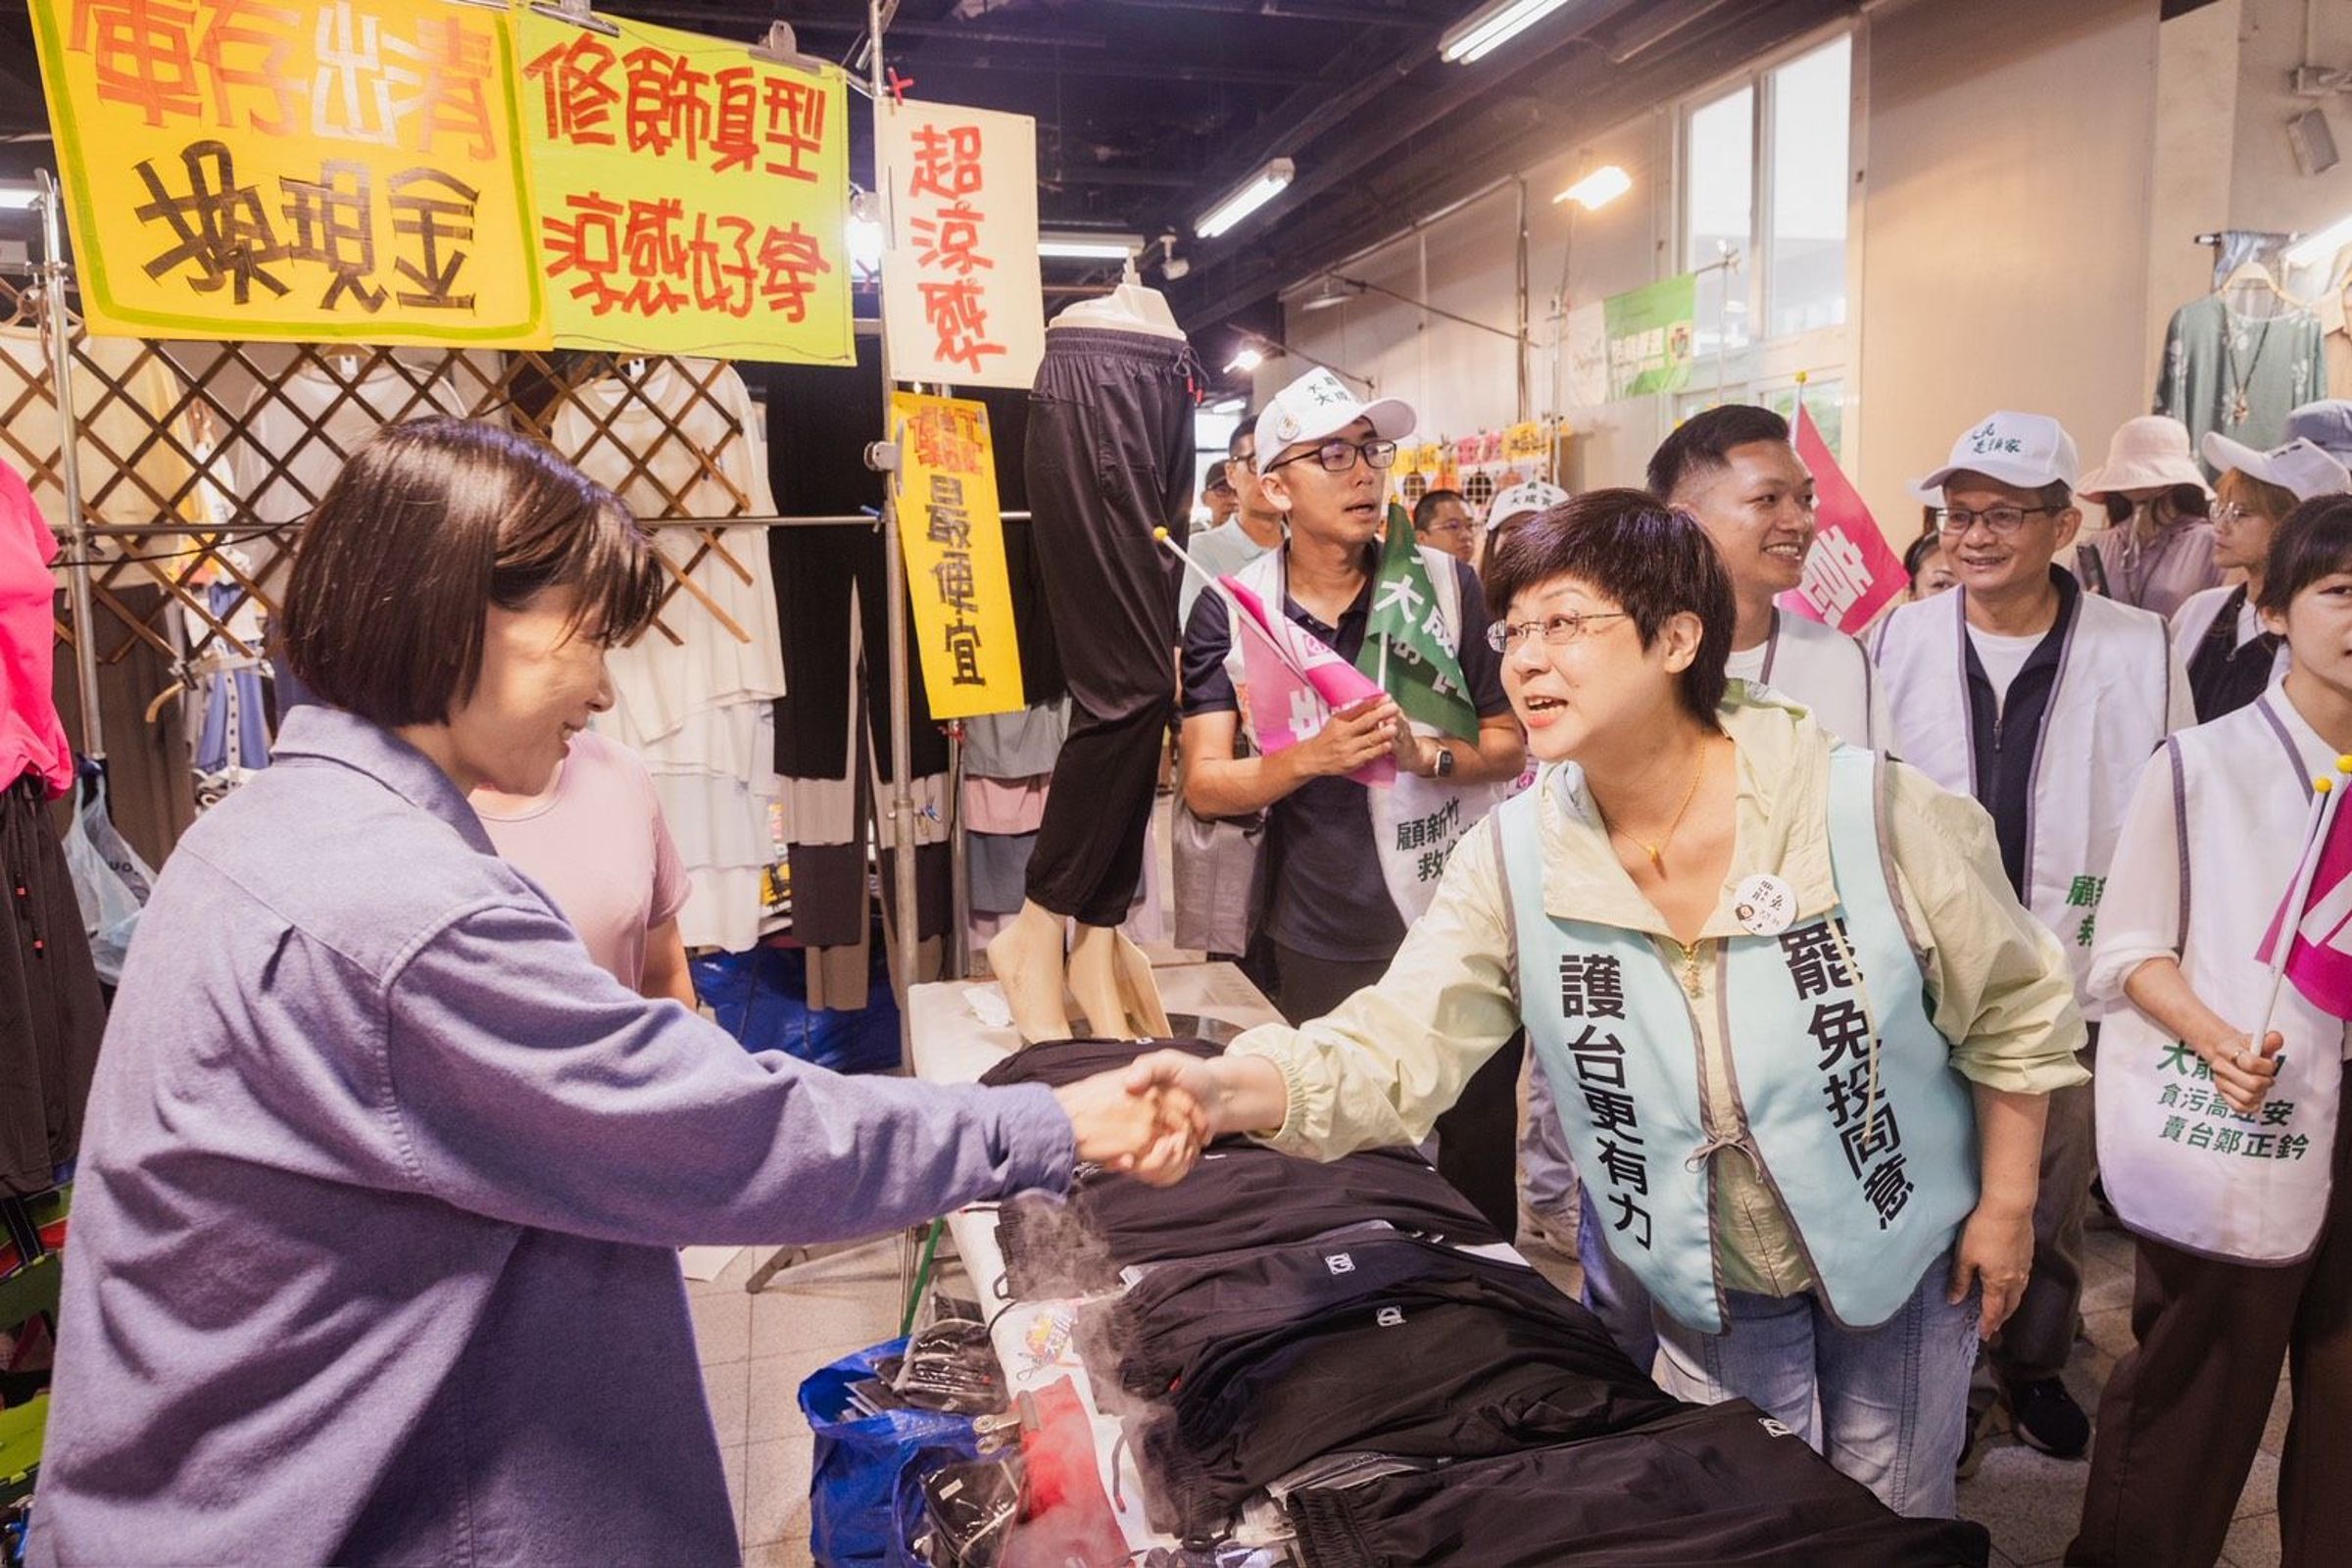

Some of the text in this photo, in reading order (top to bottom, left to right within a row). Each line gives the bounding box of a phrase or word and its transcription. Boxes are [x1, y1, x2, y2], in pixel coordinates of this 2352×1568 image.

[524, 31, 826, 184] 修飾身型
[133, 140, 480, 314] 換現金
[542, 190, 831, 323] 涼感好穿
[910, 123, 1007, 373] 超涼感
[924, 474, 987, 687] 最便宜
[1396, 796, 1460, 851] 顧新竹
[1559, 954, 1652, 1250] 護台更有力
[1779, 917, 1915, 1231] 罷免投同意
[2157, 1083, 2294, 1126] 貪污高安
[2159, 1114, 2310, 1160] 賣台鄭正鈐
